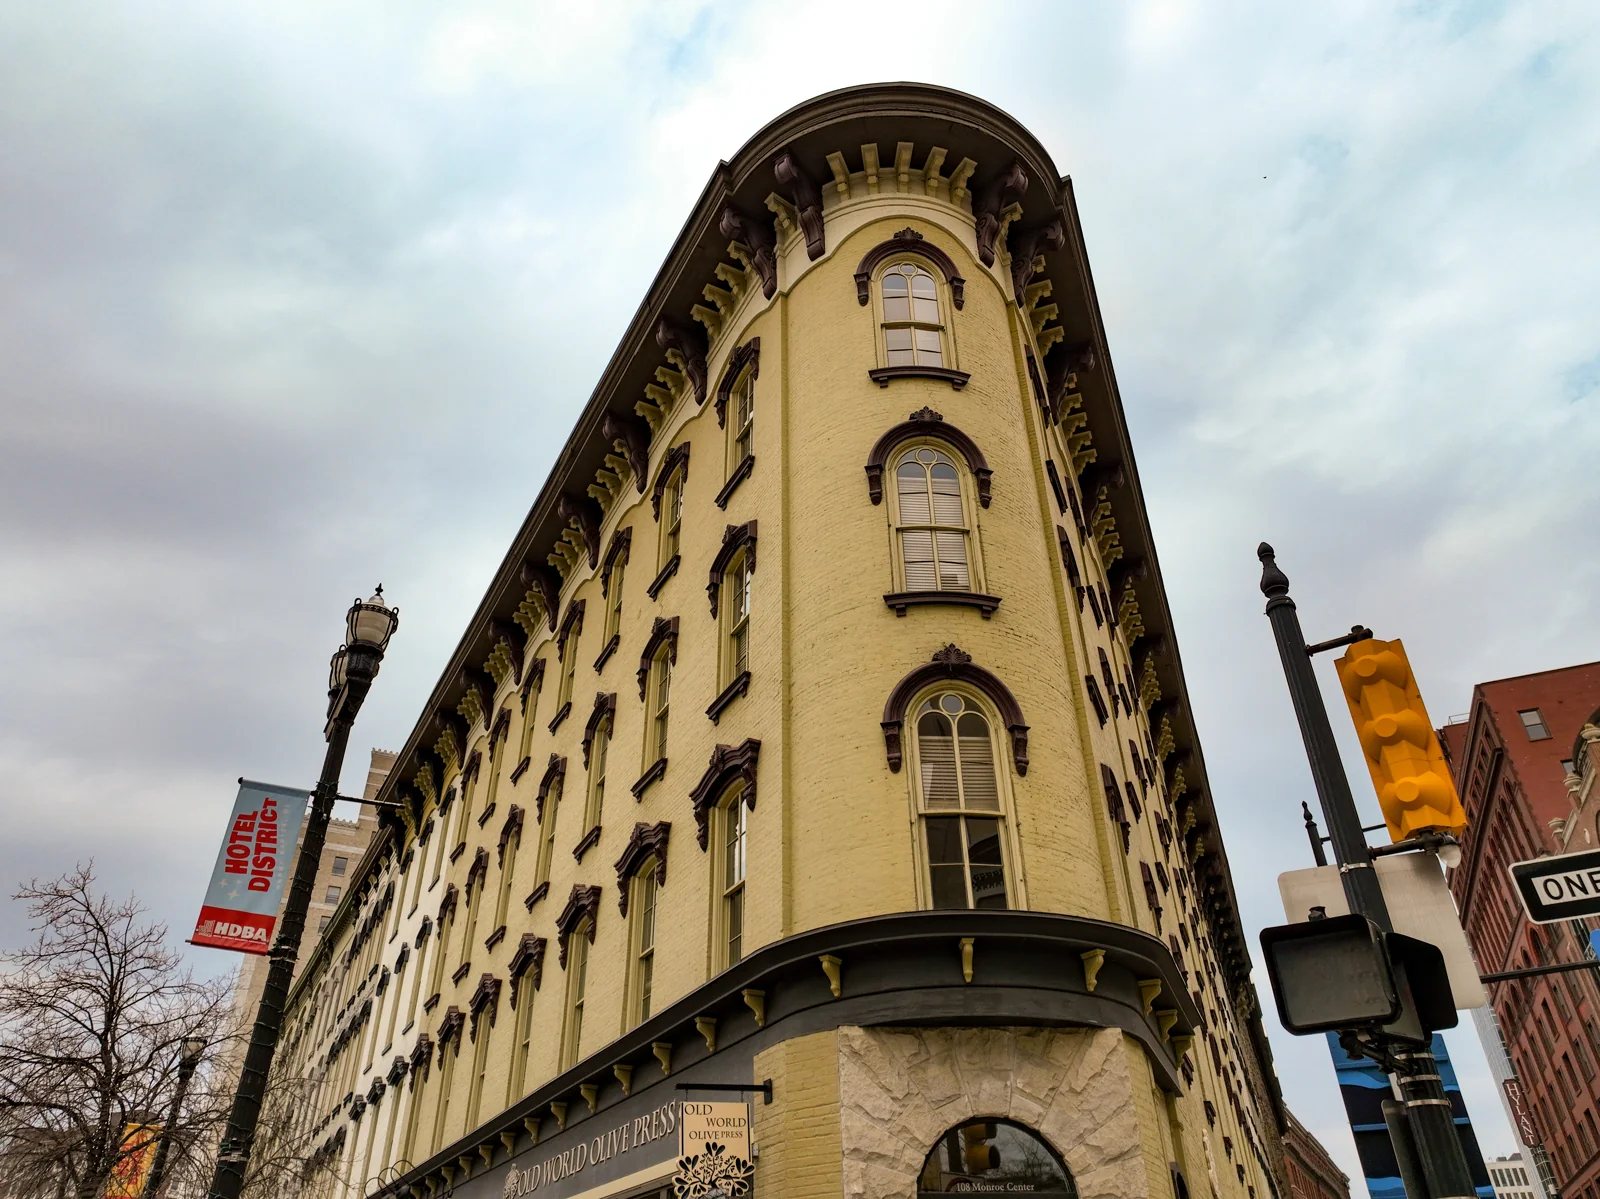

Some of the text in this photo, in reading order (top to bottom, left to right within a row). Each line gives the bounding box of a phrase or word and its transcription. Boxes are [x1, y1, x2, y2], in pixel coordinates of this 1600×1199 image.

[225, 810, 258, 875] HOTEL
[247, 797, 277, 892] DISTRICT
[1543, 870, 1600, 900] ONE
[214, 921, 267, 941] HDBA
[684, 1103, 713, 1116] OLD
[1505, 1083, 1534, 1145] HYLANT
[688, 1130, 743, 1140] OLIVE PRESS
[706, 1117, 747, 1128] WORLD
[518, 1098, 676, 1196] OLD WORLD OLIVE PRESS
[956, 1182, 1035, 1192] 108 Monroe Center
